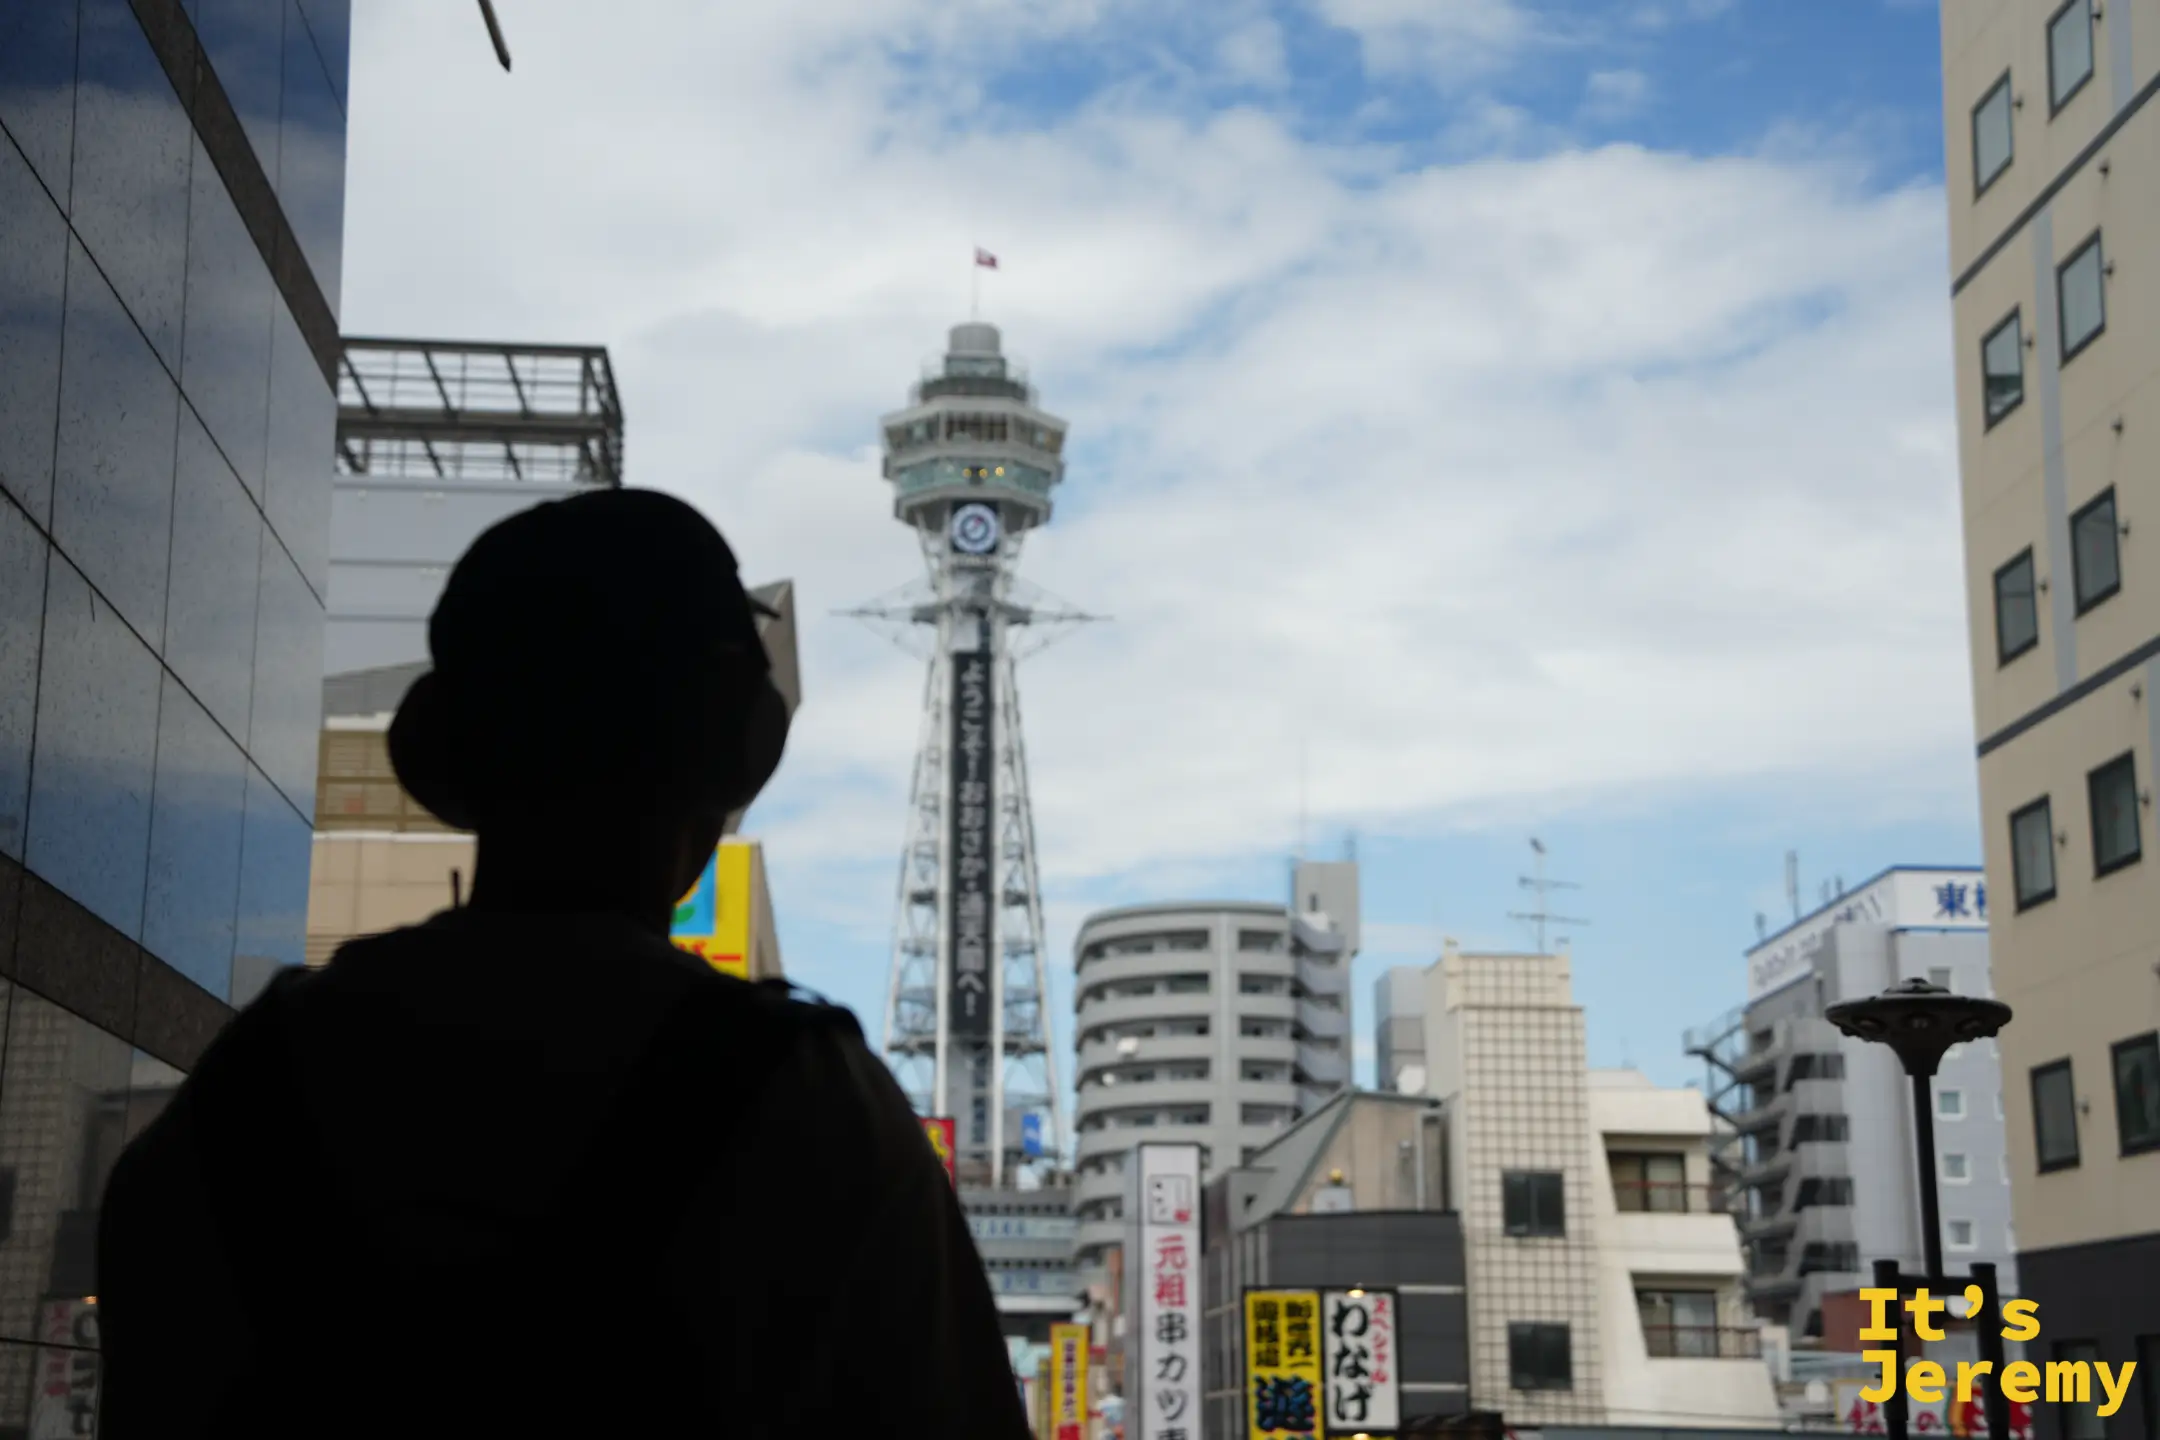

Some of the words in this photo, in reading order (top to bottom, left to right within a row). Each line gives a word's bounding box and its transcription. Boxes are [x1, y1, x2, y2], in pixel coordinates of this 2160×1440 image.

[1254, 1374, 1316, 1440] 遊
[1333, 1300, 1374, 1422] わなげ
